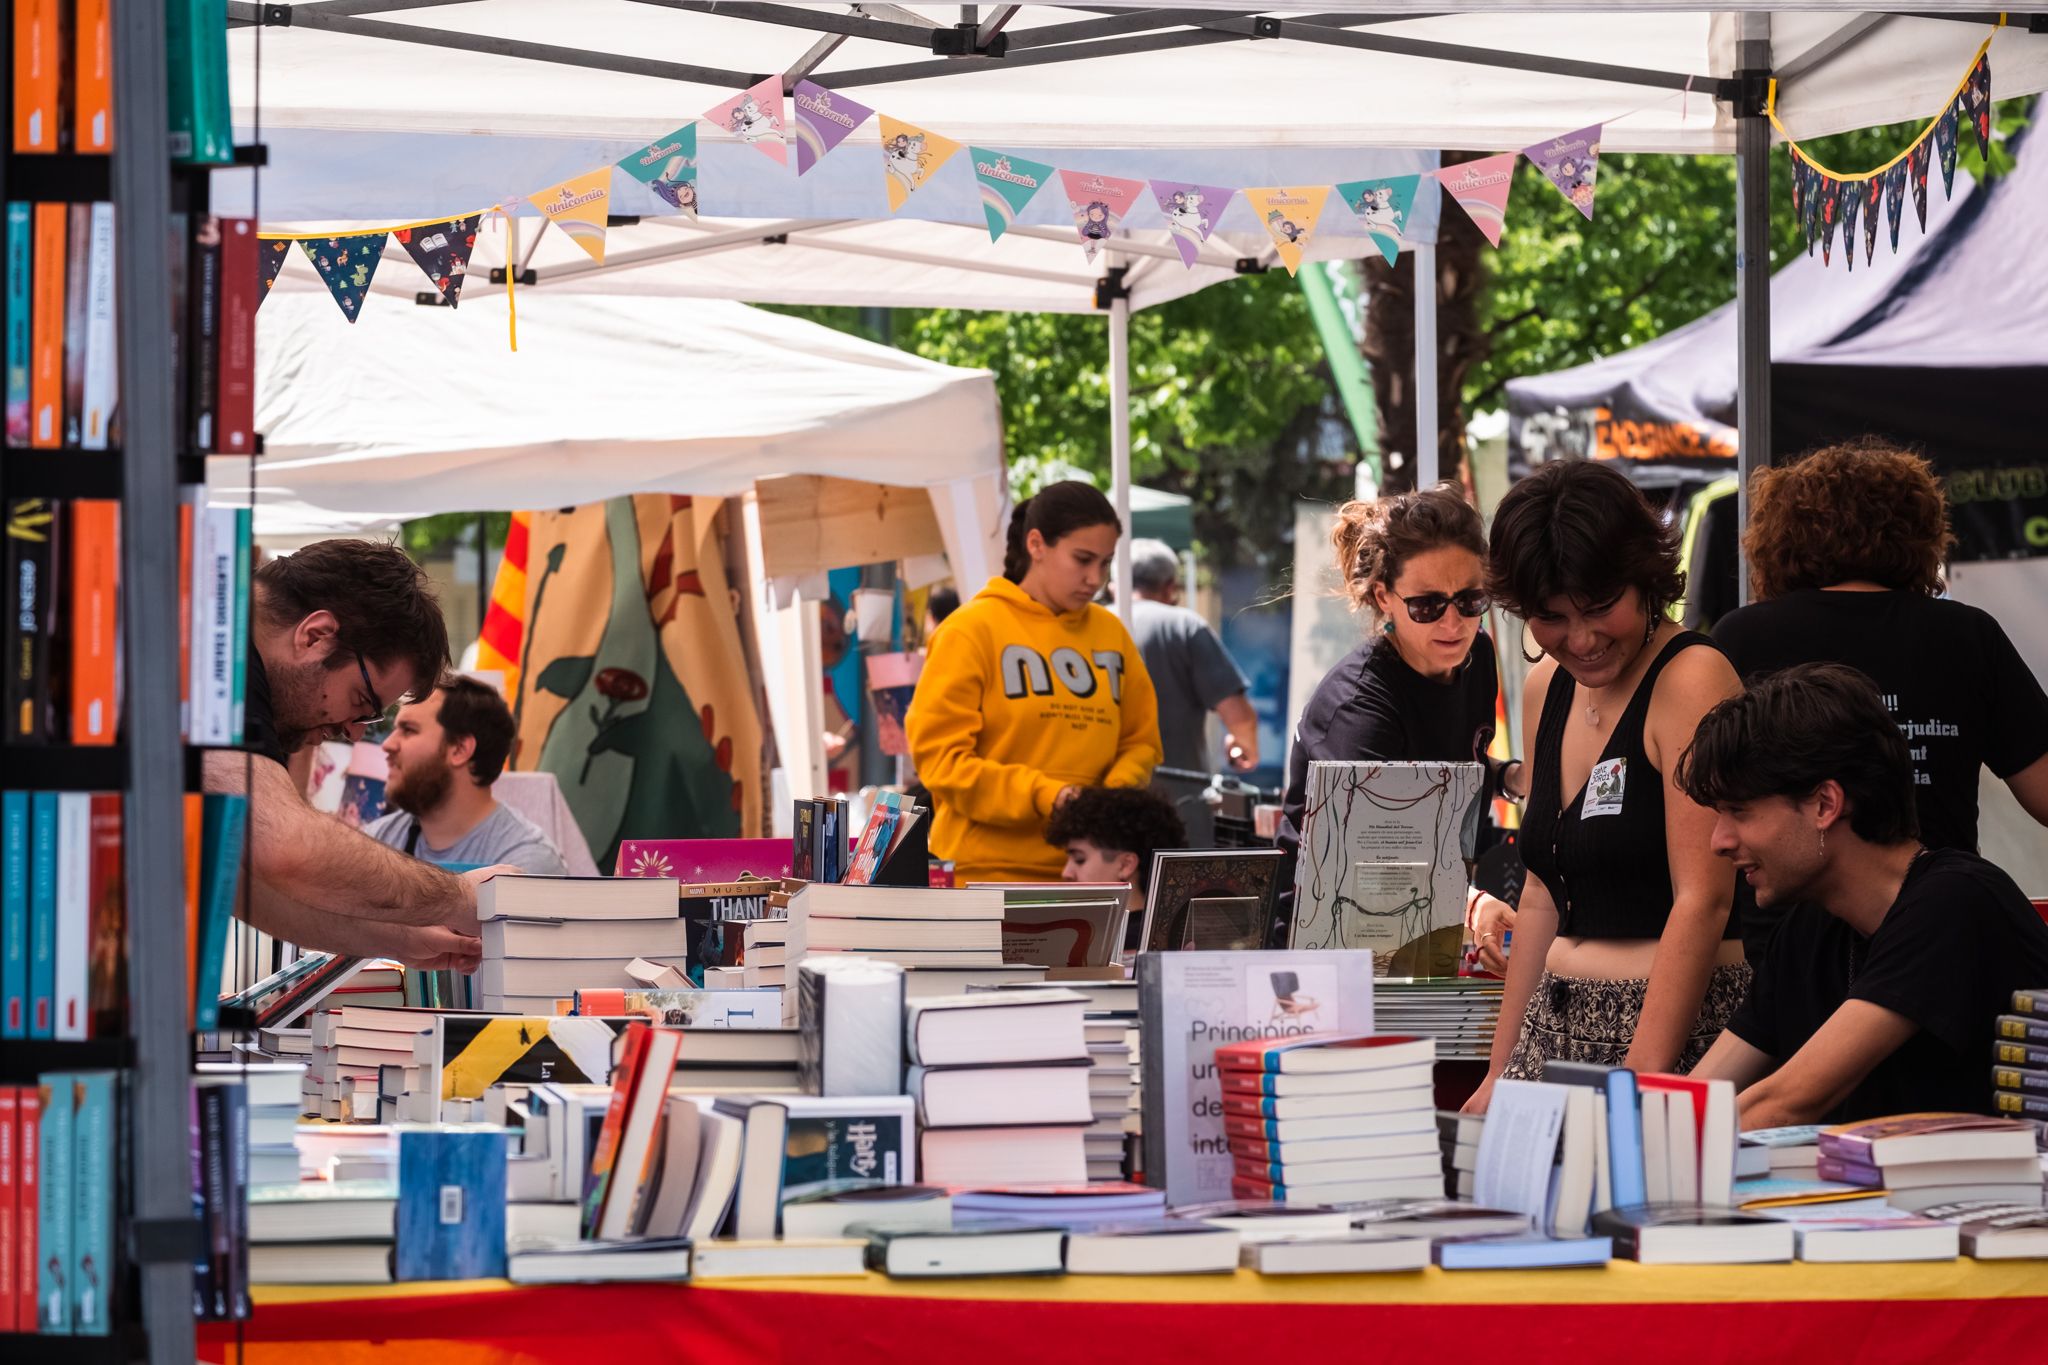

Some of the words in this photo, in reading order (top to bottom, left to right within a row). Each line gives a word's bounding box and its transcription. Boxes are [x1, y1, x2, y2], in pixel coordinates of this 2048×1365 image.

[796, 93, 856, 129] Unicornia
[640, 142, 682, 167] Unicornia
[1545, 138, 1587, 158] Unicornia
[977, 163, 1038, 189] Unicornia
[1450, 171, 1509, 193] Unicornia
[1079, 181, 1124, 198] Unicornia
[546, 187, 607, 215] Unicornia
[1266, 195, 1309, 206] Unicornia
[1896, 718, 1959, 740] rjudica
[1909, 746, 1928, 760] nt
[1914, 769, 1931, 784] ia
[1193, 1061, 1221, 1080] un
[1193, 1098, 1223, 1118] de
[846, 1122, 878, 1177] Harry
